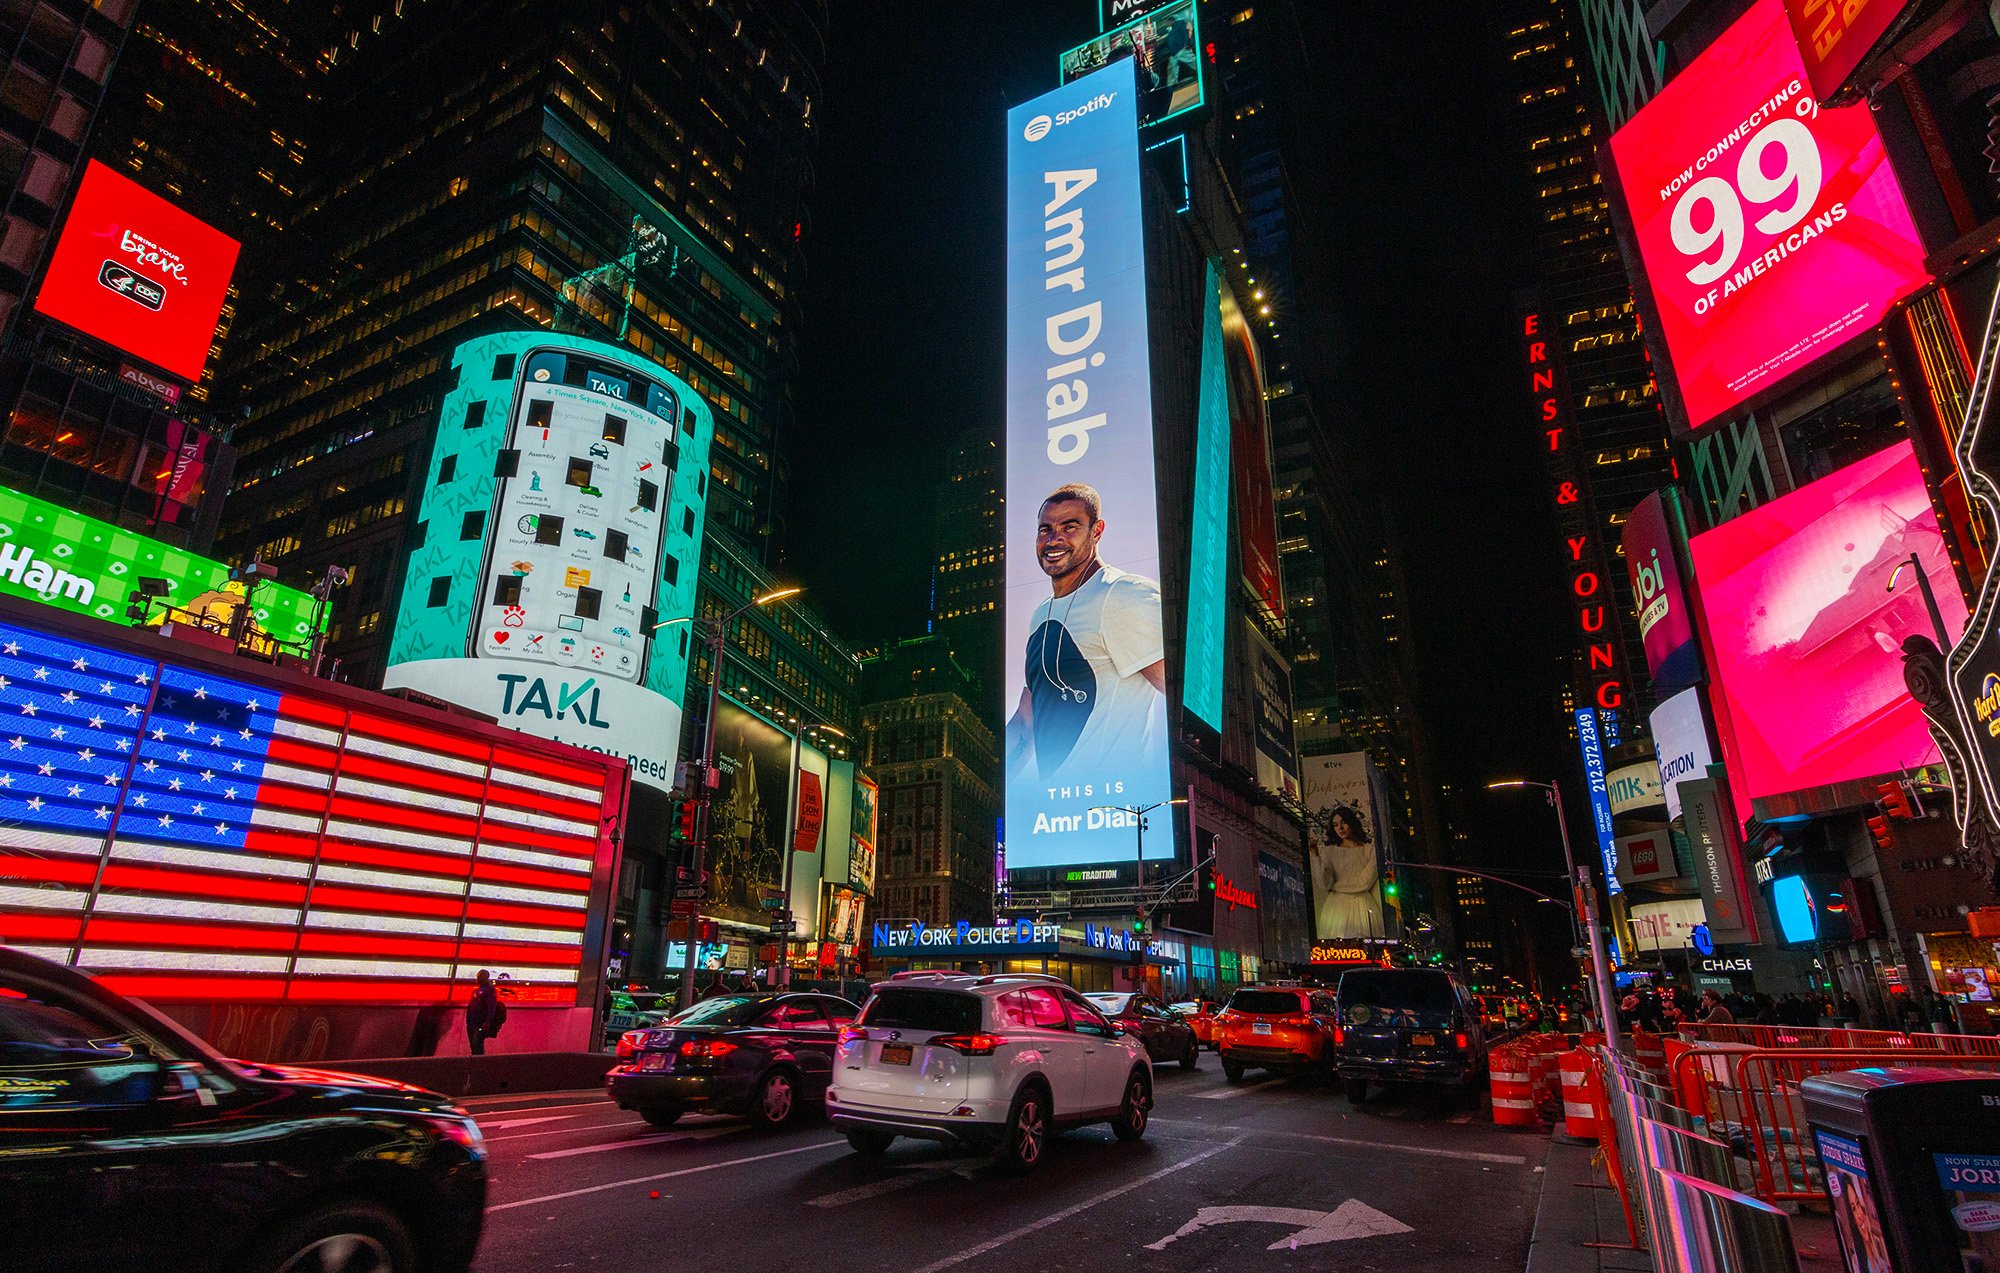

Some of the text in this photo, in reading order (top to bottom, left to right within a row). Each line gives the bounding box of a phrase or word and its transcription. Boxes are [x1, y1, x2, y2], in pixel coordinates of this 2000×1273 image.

[1055, 93, 1114, 127] Spotify
[1660, 79, 1802, 201] NOW CONNECTING
[132, 233, 180, 262] BRING YOUR
[1693, 203, 1848, 315] OF AMERICANS
[137, 284, 161, 301] CDC
[1044, 168, 1107, 466] Amr Diab
[591, 379, 623, 399] TAKL
[1525, 314, 1563, 450] ERNST
[554, 388, 577, 399] Times
[579, 394, 609, 408] Square,
[611, 402, 628, 414] New
[629, 408, 646, 422] York,
[647, 417, 658, 426] NY
[564, 412, 579, 421] you
[528, 450, 557, 461] Assembly
[520, 493, 544, 503] Cleaning
[1557, 482, 1578, 505] &
[516, 499, 551, 510] Housekeeping
[579, 503, 599, 513] Delivery
[581, 510, 600, 519] Courier
[624, 516, 650, 531] Handyman
[509, 538, 529, 546] Hourly
[571, 553, 592, 562] Removal
[0, 542, 95, 606] Ham
[1632, 548, 1665, 612] ubi
[614, 604, 635, 616] Painting
[1568, 536, 1622, 709] YOUNG
[497, 673, 610, 730] TAKL
[1578, 713, 1606, 793] 212.372.2349
[628, 754, 668, 782] need
[1661, 752, 1695, 785] CATION
[805, 792, 817, 804] THE
[1048, 781, 1124, 800] THIS IS
[801, 802, 819, 816] LION
[800, 816, 820, 832] KING
[1032, 806, 1142, 835] Amr Diab
[1633, 850, 1654, 864] LEGO
[1066, 869, 1118, 881] NEWTRADITION
[1703, 843, 1721, 895] THOMSON
[1754, 857, 1773, 885] AT&T
[873, 918, 1061, 948] NEW YORK POLICE DEPT
[1085, 921, 1105, 948] NEW
[1104, 925, 1124, 951] YORK
[1311, 946, 1368, 960] Subway
[1703, 959, 1753, 971] CHASE
[612, 1015, 632, 1026] NYPD
[1944, 1157, 1970, 1166] NOW
[1970, 1209, 1989, 1218] SARA
